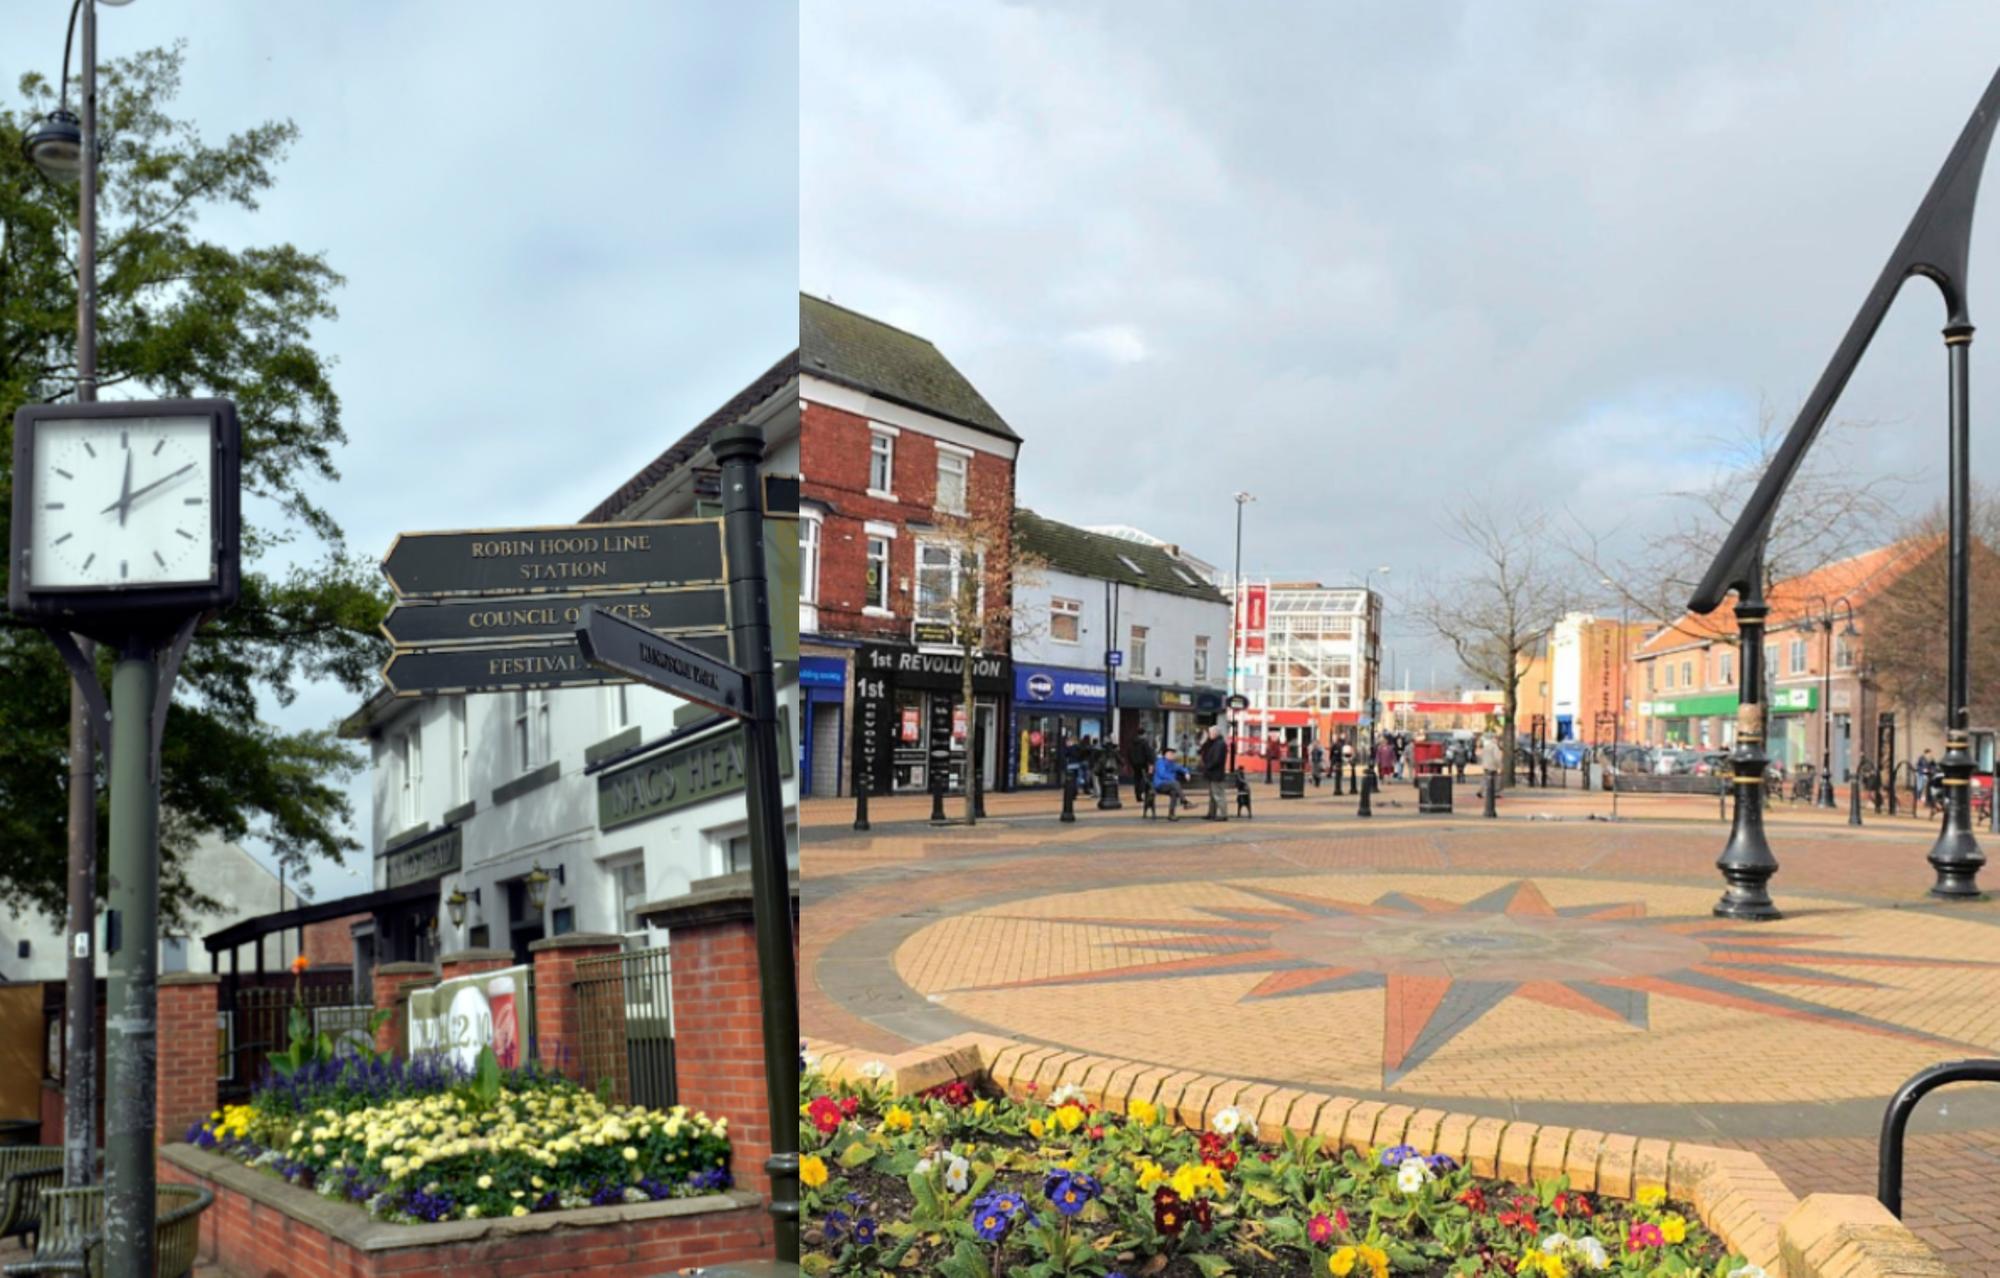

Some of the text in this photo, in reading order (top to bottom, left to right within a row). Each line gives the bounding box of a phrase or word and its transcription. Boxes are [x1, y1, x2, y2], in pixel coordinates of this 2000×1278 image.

[471, 535, 651, 558] ROBIN HOOD LINE
[519, 561, 607, 580] STATION
[468, 608, 560, 628] COUNCIL
[489, 655, 580, 675] FESTIVAL
[869, 650, 1001, 677] 1st REVOLUION
[857, 677, 885, 698] 1st
[610, 736, 745, 819] NAGS HEA
